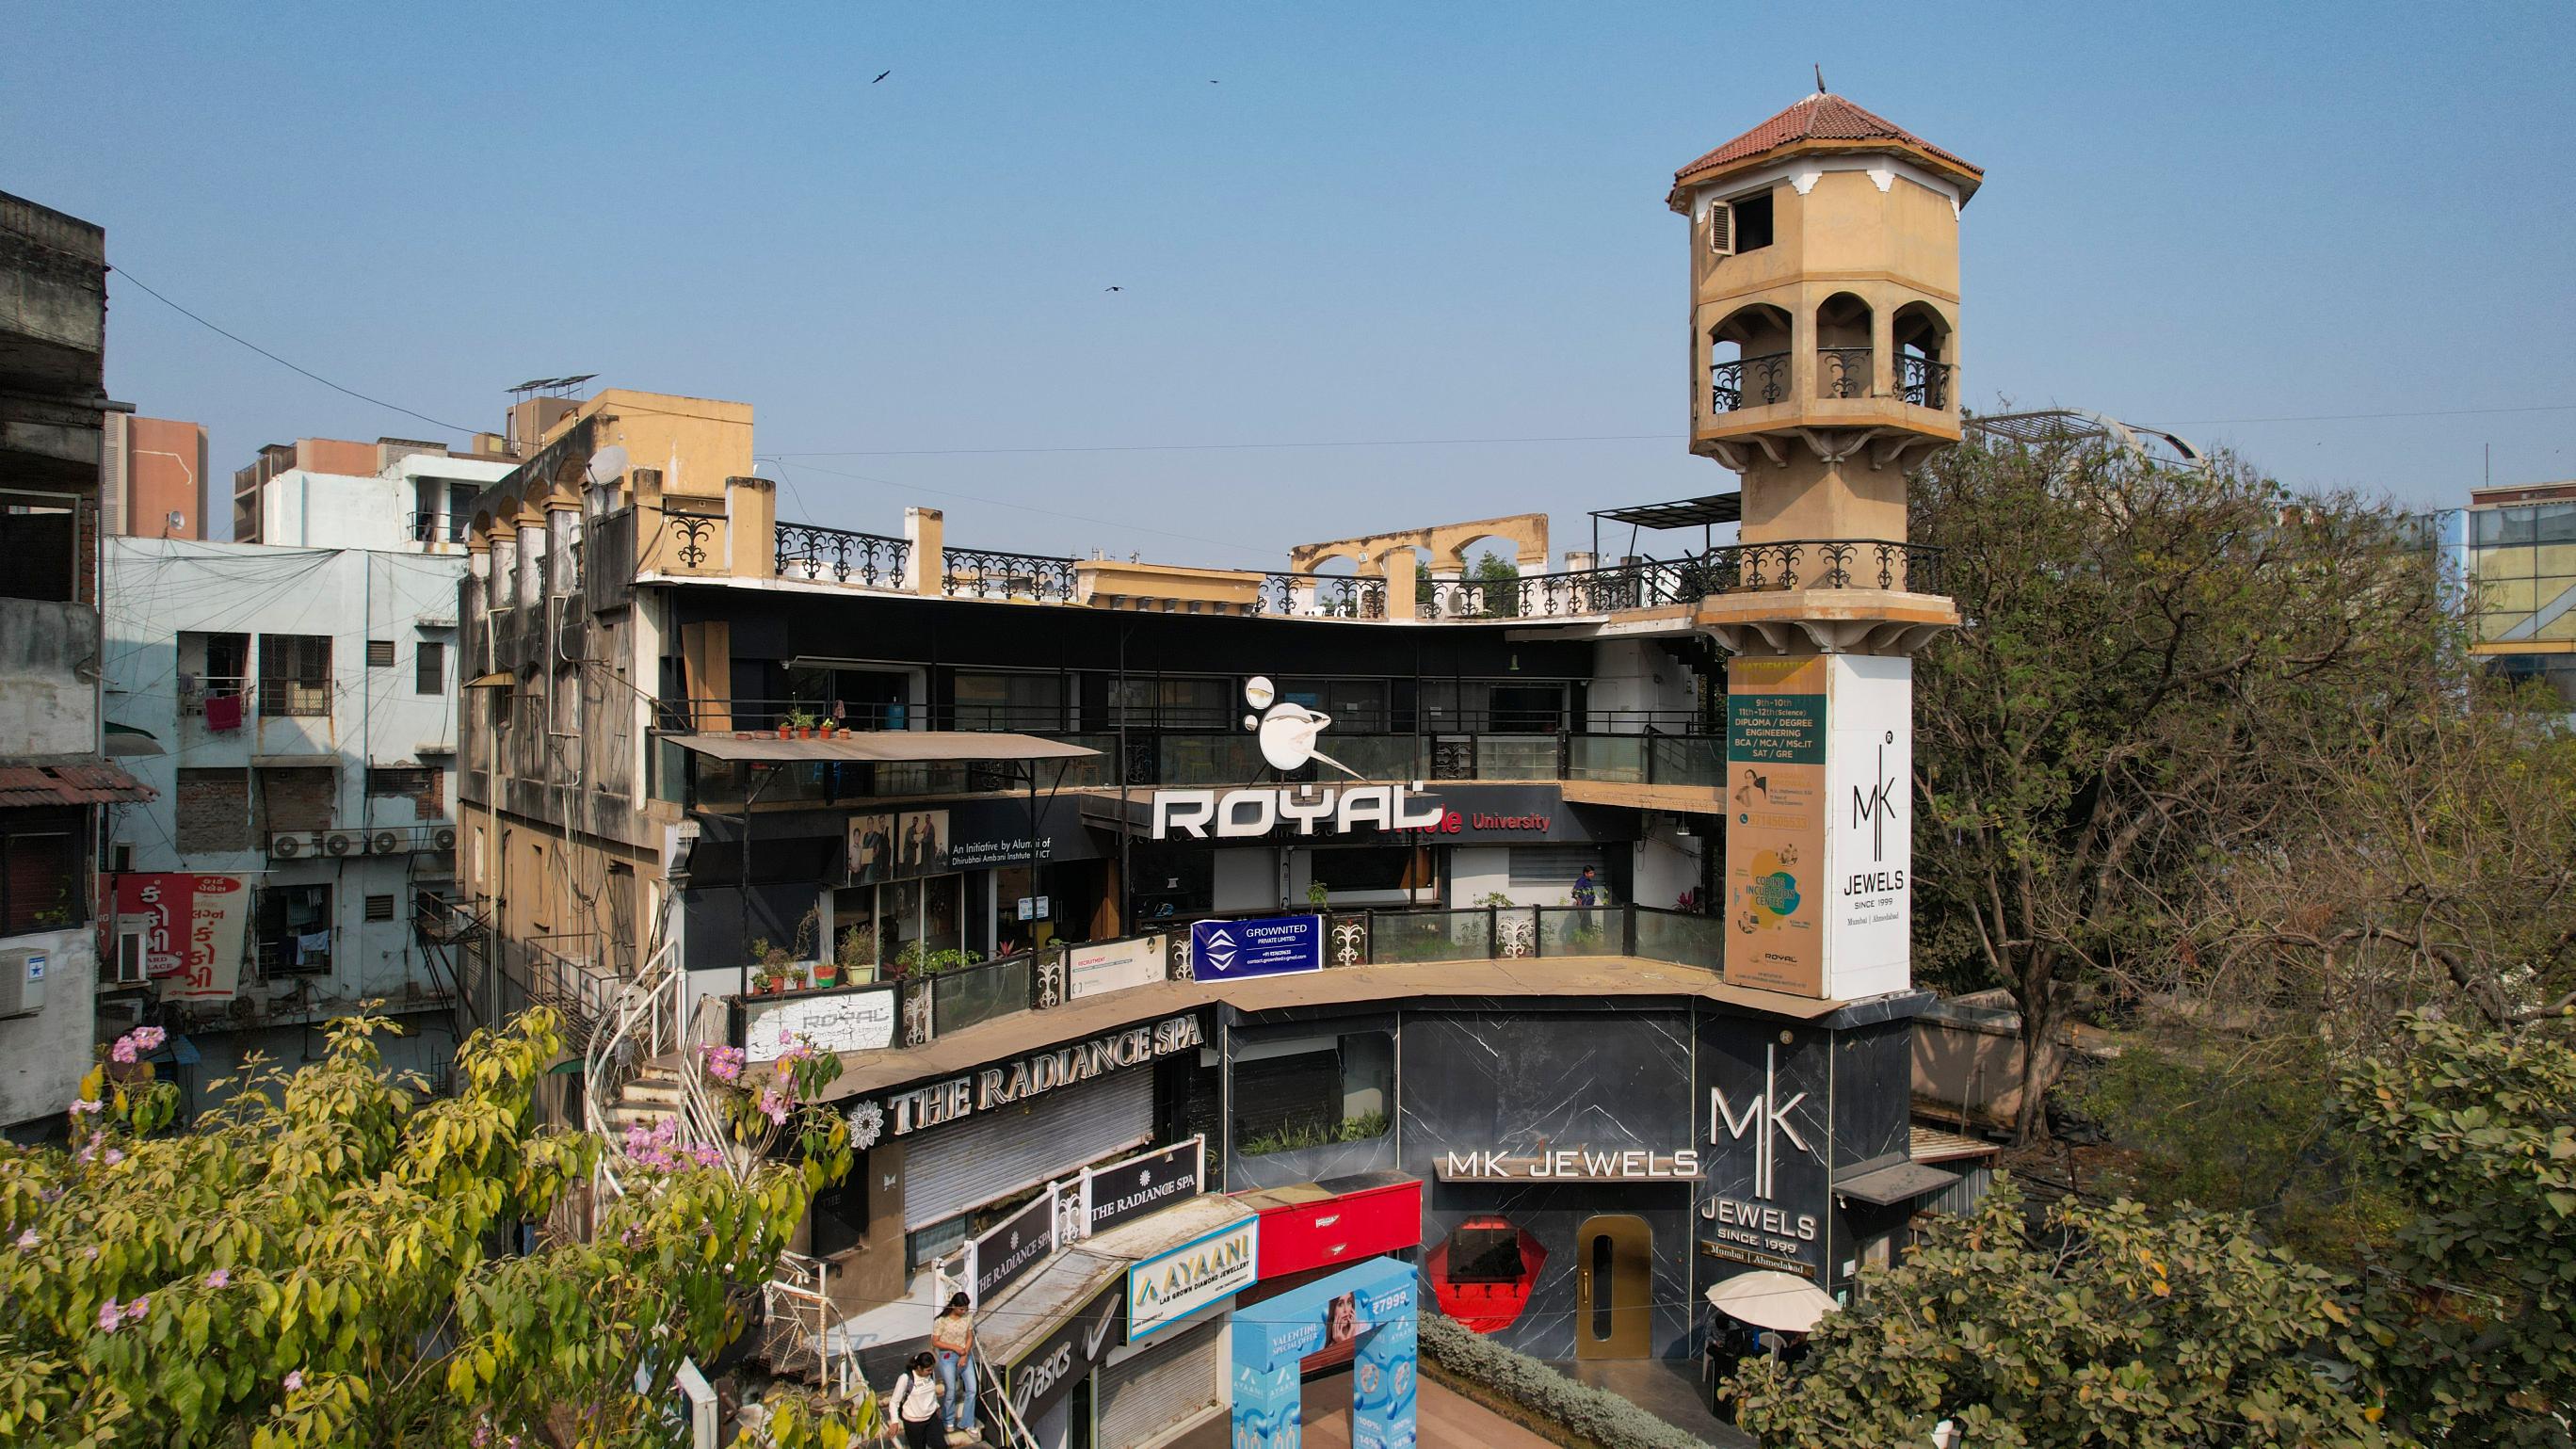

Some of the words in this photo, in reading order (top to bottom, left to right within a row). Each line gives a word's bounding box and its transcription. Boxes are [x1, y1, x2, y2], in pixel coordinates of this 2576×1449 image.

[1735, 718, 1771, 727] DIPLOMA
[1779, 718, 1813, 727] DEGREE
[1734, 738, 1751, 747] BCA
[1746, 729, 1801, 737] ENGINEERING
[1776, 749, 1794, 758] GRE
[1152, 781, 1443, 839] ROYAL
[1472, 813, 1552, 832] University
[952, 845, 964, 854] An
[966, 841, 998, 853] Initiative
[1001, 840, 1010, 852] by
[1041, 837, 1051, 847] of
[952, 856, 981, 865] Dhirubhai
[982, 854, 1006, 862] Ambani
[1039, 849, 1051, 858] ICT
[1755, 876, 1786, 887] CODING
[1843, 870, 1904, 896] JEWELS
[1746, 885, 1795, 899] INCUBATION
[1755, 896, 1785, 909] CENTER
[1854, 900, 1875, 910] SINCE
[1877, 897, 1893, 906] 1999
[1847, 917, 1868, 926] Mumbai
[1872, 912, 1899, 923] Ahmedabad
[1246, 925, 1308, 938] GROWNITED
[1077, 957, 1106, 966] RECRUITMENT
[1764, 953, 1798, 962] ROYAL
[803, 1007, 890, 1029] ROYAL
[887, 1076, 972, 1136] THE
[977, 1026, 1151, 1111] RADIANCE
[1154, 1013, 1204, 1055] SPA
[1710, 1043, 1809, 1200] MK
[1447, 1150, 1510, 1177] MK
[1529, 1150, 1699, 1177] JEWELS
[1091, 1202, 1115, 1222] THE
[1117, 1181, 1175, 1211] RADIANCE
[1176, 1174, 1196, 1191] SPA
[1700, 1197, 1816, 1241] JEWELS
[1716, 1228, 1759, 1247] SINCE
[1764, 1237, 1796, 1253] 1999
[978, 1272, 991, 1294] HE
[992, 1239, 1037, 1284] RADIANCE
[1038, 1230, 1052, 1249] SPA
[1162, 1234, 1249, 1294] AYAANI
[1711, 1245, 1745, 1261] Mumbai
[1753, 1254, 1804, 1274] Ahmedabad
[1159, 1296, 1170, 1305] LAB
[1171, 1286, 1193, 1300] GROWN
[1194, 1274, 1218, 1290] DIAMOND
[1219, 1261, 1249, 1279] JEWELLERY
[1272, 1323, 1318, 1347] VALENTINE
[1272, 1339, 1298, 1357] SPECIAL
[1297, 1331, 1318, 1350] OFFER
